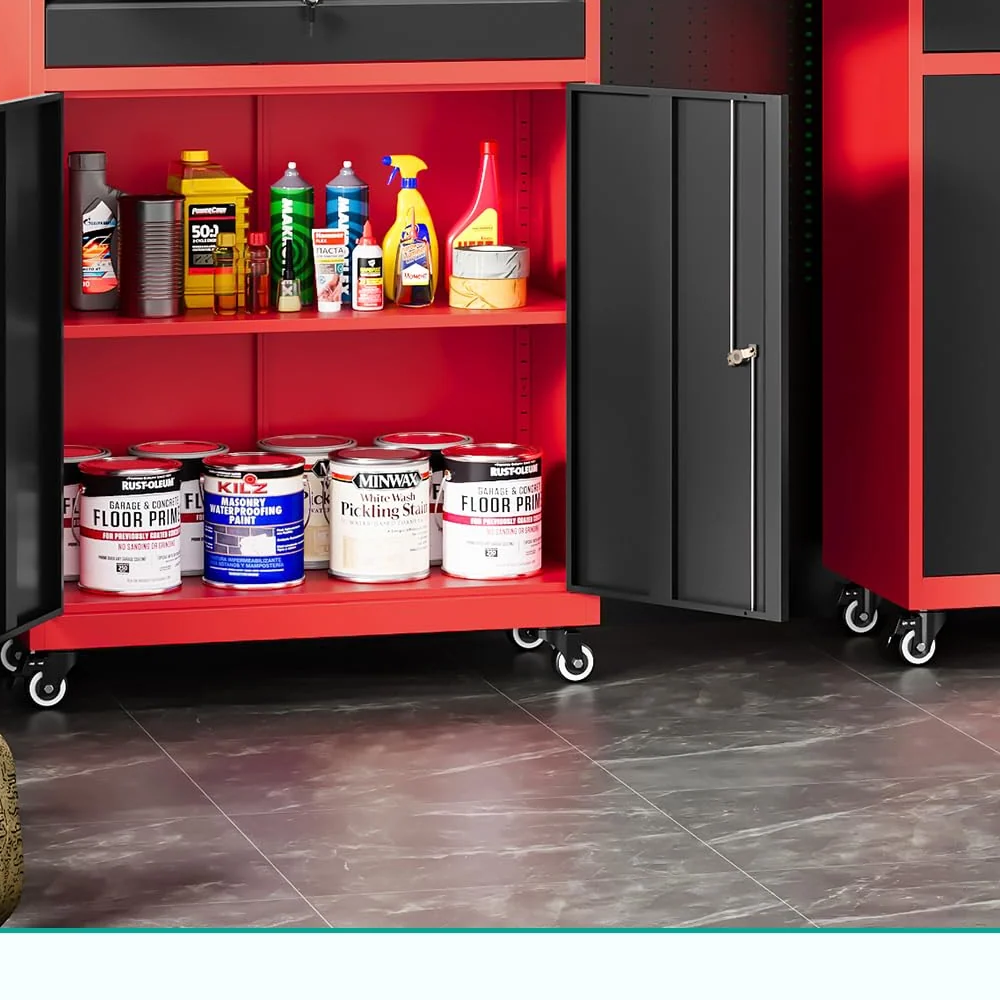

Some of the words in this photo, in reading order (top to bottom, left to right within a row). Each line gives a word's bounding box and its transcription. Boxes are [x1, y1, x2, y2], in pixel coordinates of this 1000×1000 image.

[490, 464, 538, 477] RUST-OLEUM
[122, 477, 175, 491] RUST-OLEUM
[217, 480, 268, 494] KILZ
[359, 473, 418, 488] MINWAX
[221, 496, 266, 507] MASONRY
[360, 493, 390, 503] White
[392, 492, 416, 502] Wash
[461, 495, 510, 513] FLOOR
[109, 501, 141, 510] GARAGE
[144, 501, 150, 510] &
[210, 504, 283, 515] WATERPROOFING
[341, 501, 400, 520] Pickling
[402, 501, 428, 517] Stain
[93, 509, 142, 528] FLOOR
[229, 516, 257, 525] PAINT
